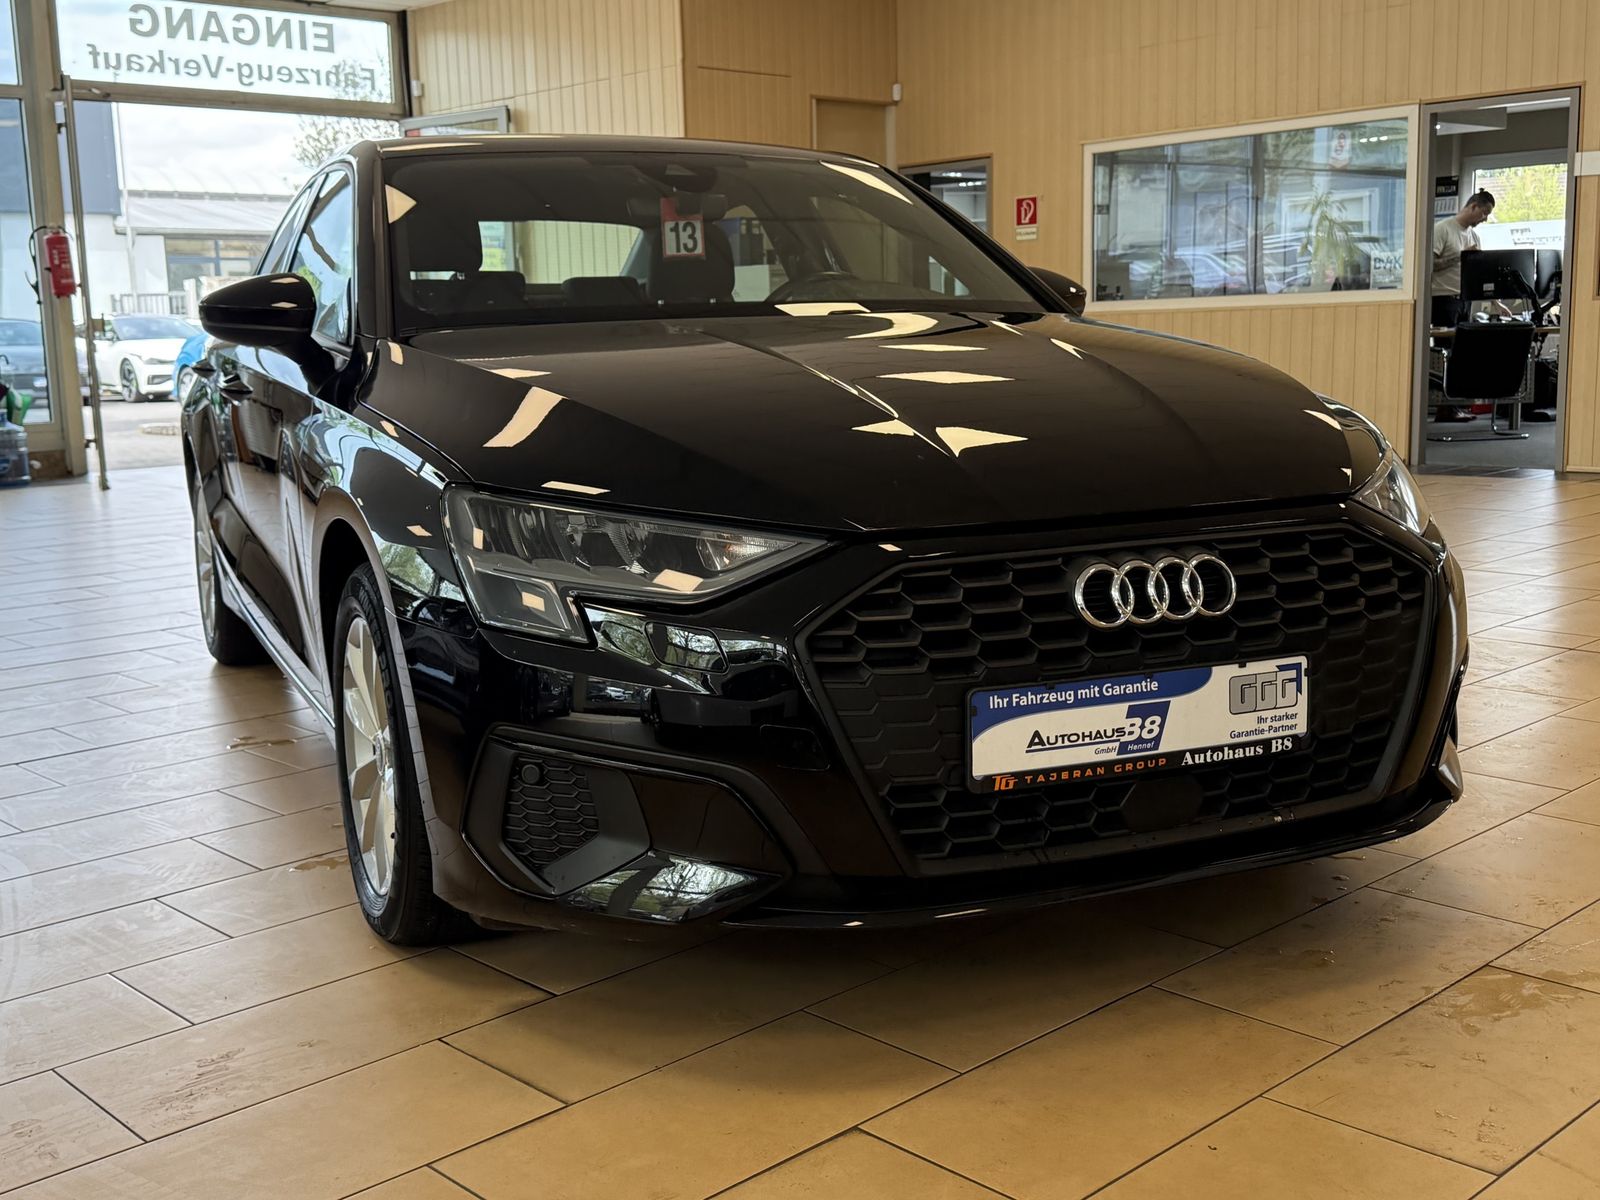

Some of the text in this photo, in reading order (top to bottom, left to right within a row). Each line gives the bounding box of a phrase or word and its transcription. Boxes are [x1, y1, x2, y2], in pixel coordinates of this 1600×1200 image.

[669, 221, 698, 253] 13
[989, 679, 1159, 709] Ihr Fahrzeug mit Garantie
[1257, 712, 1298, 724] Ihr starker
[1230, 723, 1298, 739] Garantie-Partner
[1094, 745, 1117, 755] GmbH
[1128, 740, 1155, 751] Hennef
[1181, 737, 1293, 766] Autohaus B8
[1114, 758, 1167, 773] GROUP
